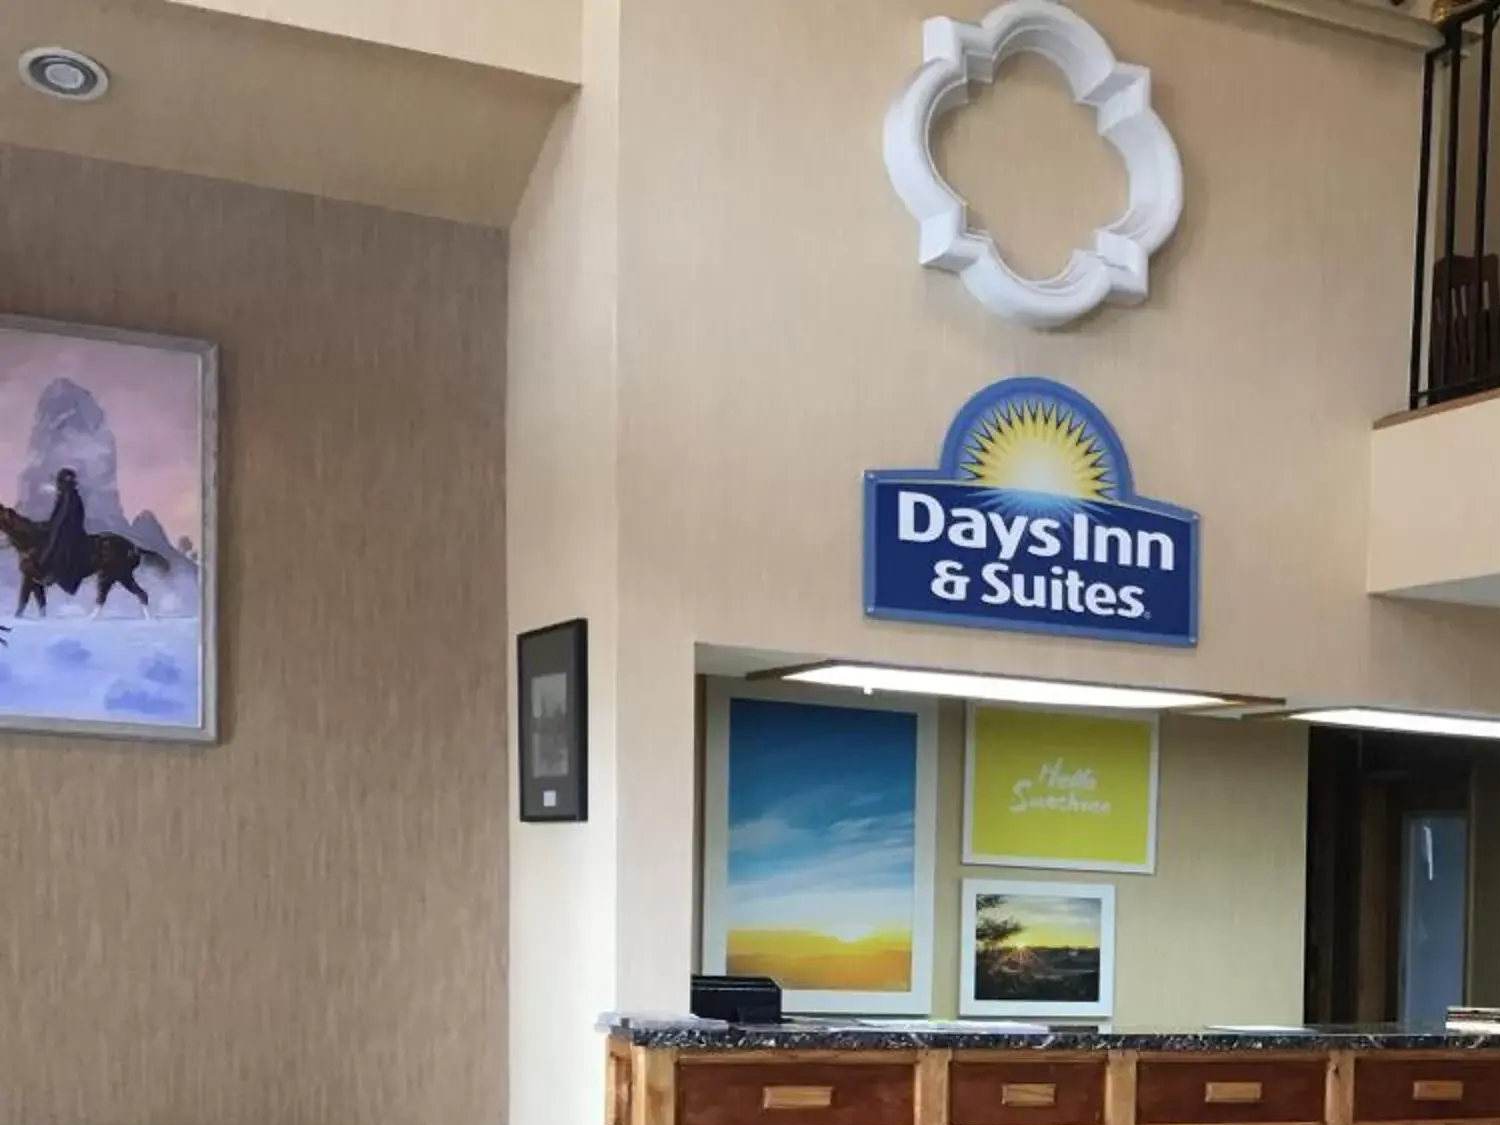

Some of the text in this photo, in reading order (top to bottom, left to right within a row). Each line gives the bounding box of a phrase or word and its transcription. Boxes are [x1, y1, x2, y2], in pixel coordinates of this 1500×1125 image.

[898, 491, 1174, 570] Days Inn
[931, 560, 1145, 618] & Suites
